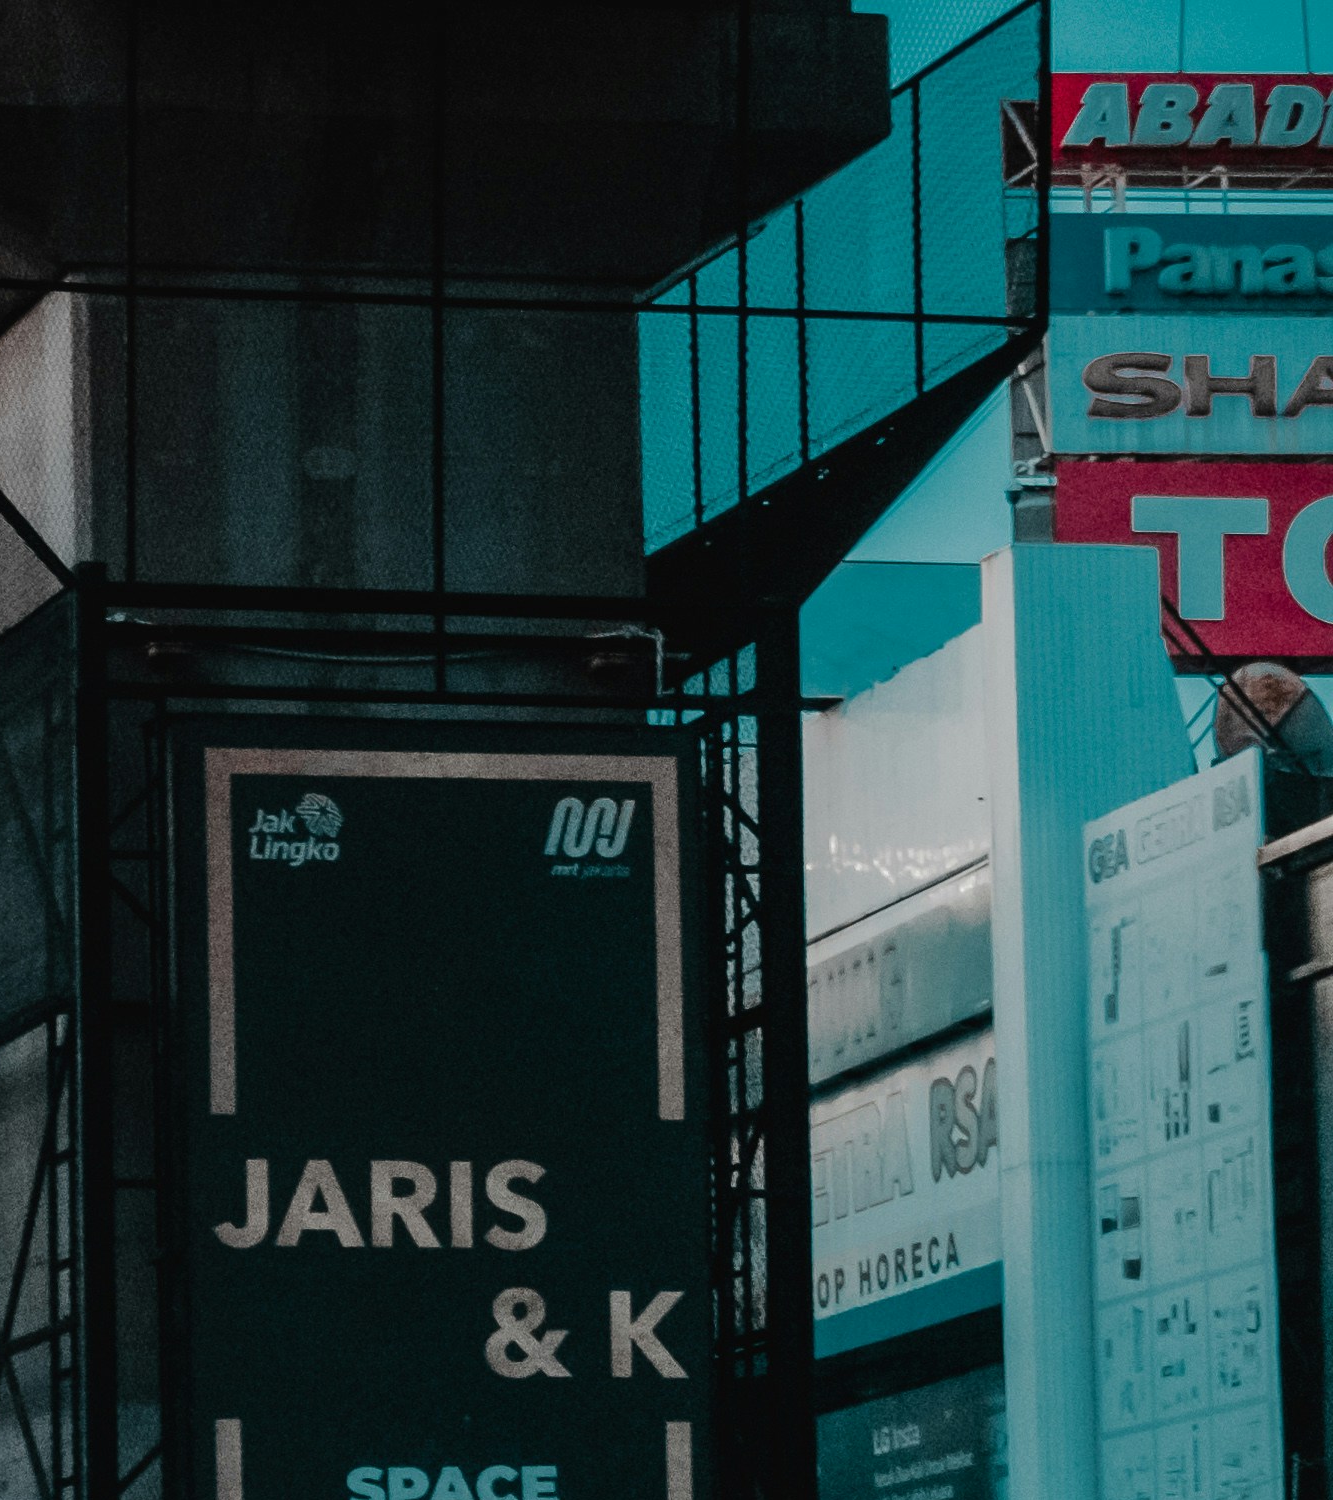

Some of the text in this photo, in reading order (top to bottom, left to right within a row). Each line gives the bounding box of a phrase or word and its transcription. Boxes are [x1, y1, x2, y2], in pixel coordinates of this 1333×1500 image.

[1060, 82, 1333, 149] ABAD
[248, 808, 296, 834] Jak
[249, 835, 341, 867] Lingko
[214, 1158, 549, 1251] JARIS
[858, 1231, 961, 1298] HORECA
[485, 1287, 689, 1379] & K
